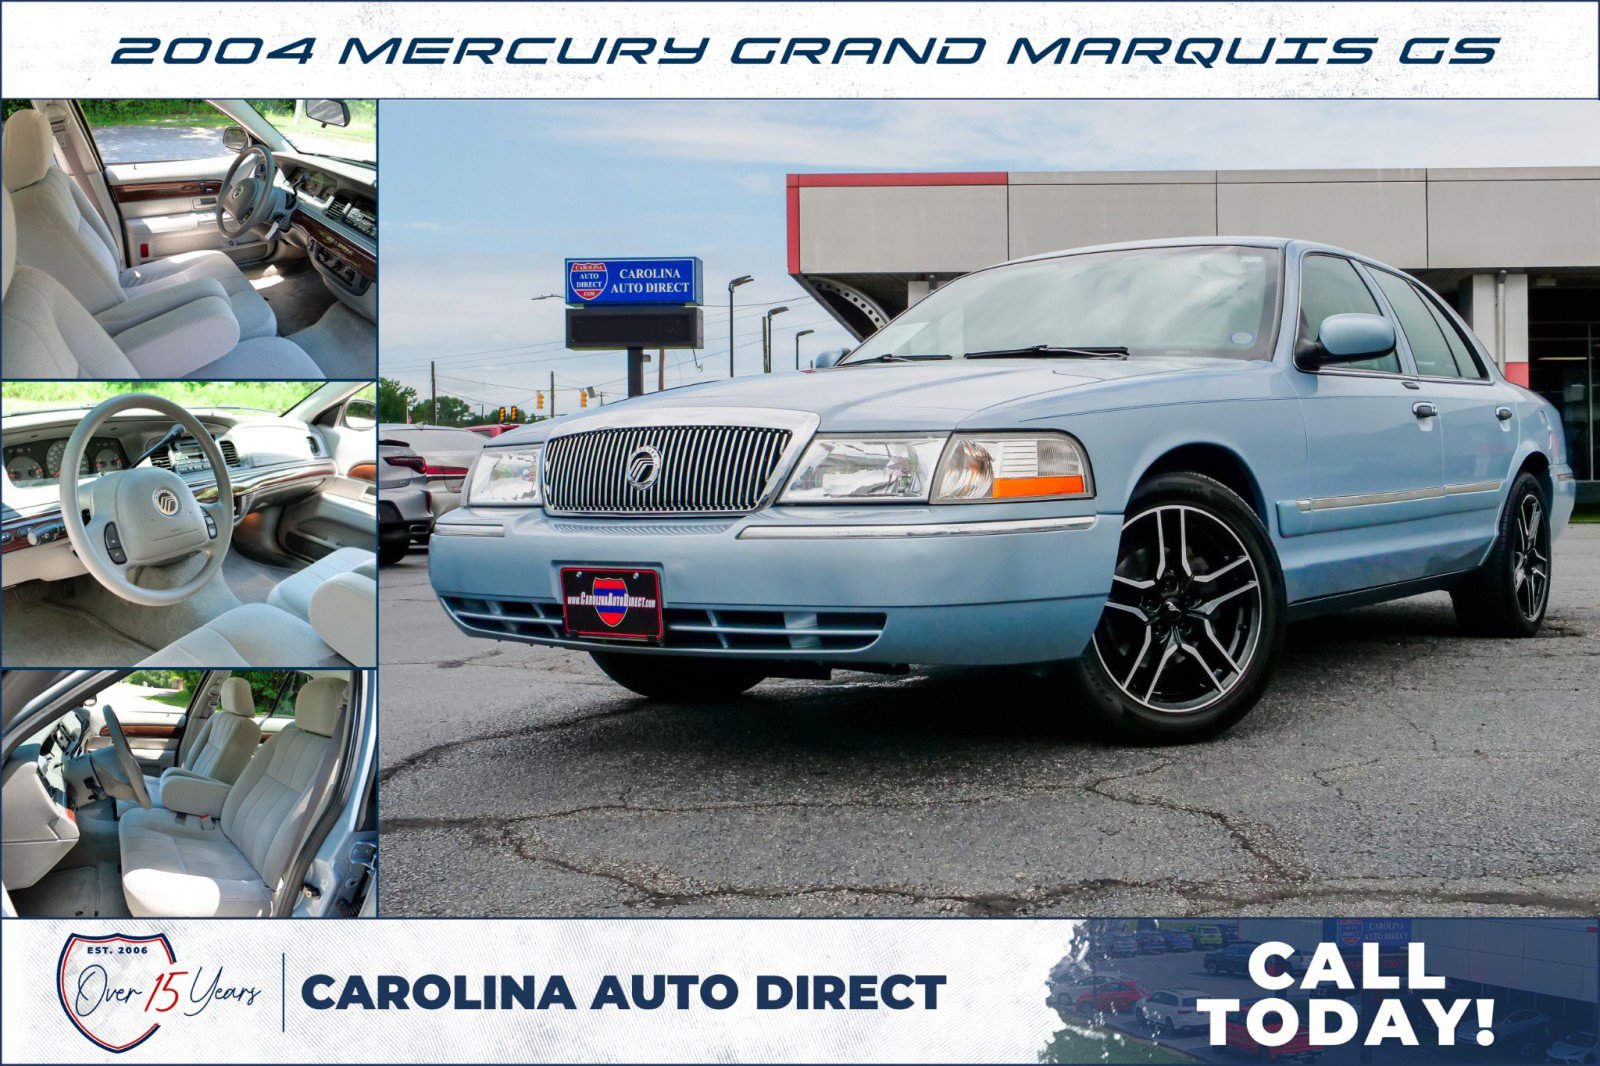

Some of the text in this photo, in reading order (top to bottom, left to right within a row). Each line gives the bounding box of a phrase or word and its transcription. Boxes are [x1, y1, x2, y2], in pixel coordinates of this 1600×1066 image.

[619, 268, 681, 279] CAROLINA
[610, 281, 690, 294] AUTO DIRECT
